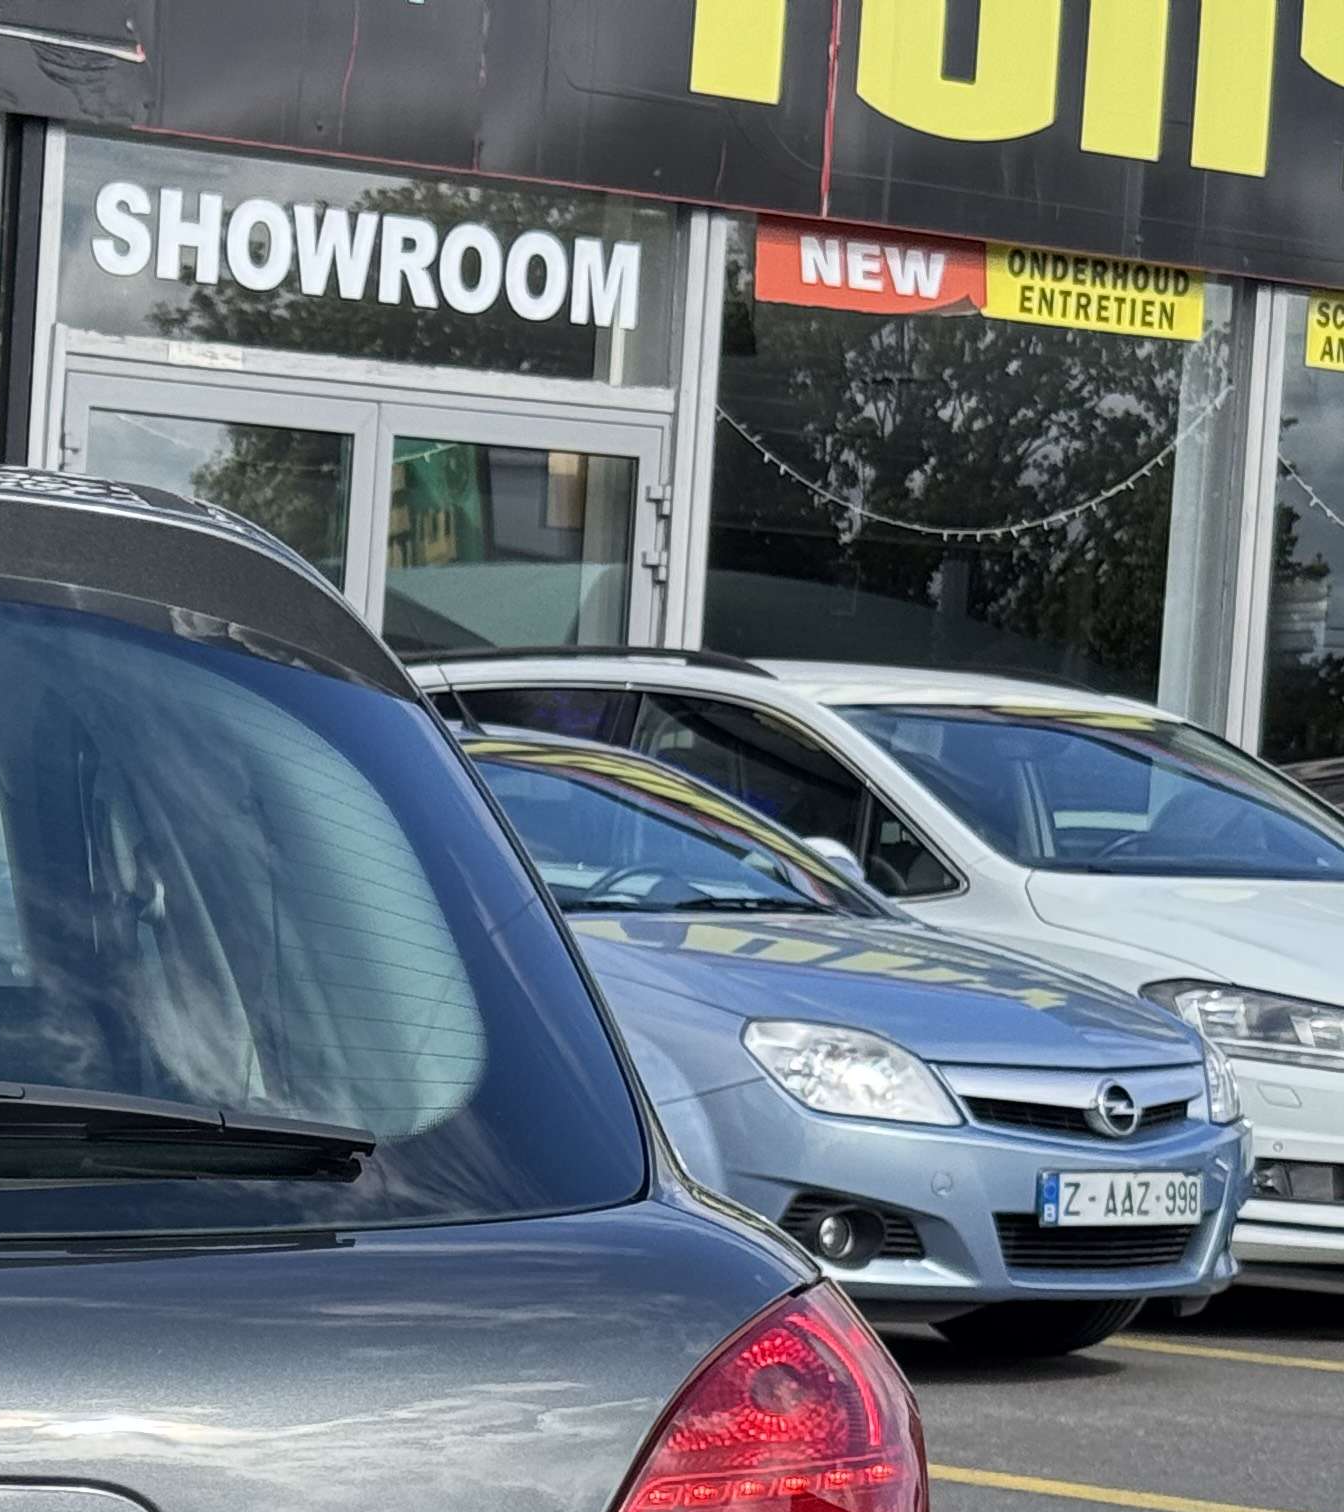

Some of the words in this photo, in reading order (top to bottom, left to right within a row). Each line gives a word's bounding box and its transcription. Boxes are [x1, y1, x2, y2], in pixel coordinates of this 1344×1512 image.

[91, 181, 642, 331] SHOWROOM
[799, 235, 946, 300] NEW
[1007, 249, 1190, 297] ONDERHOUD
[1018, 285, 1176, 332] ENTRETIEN
